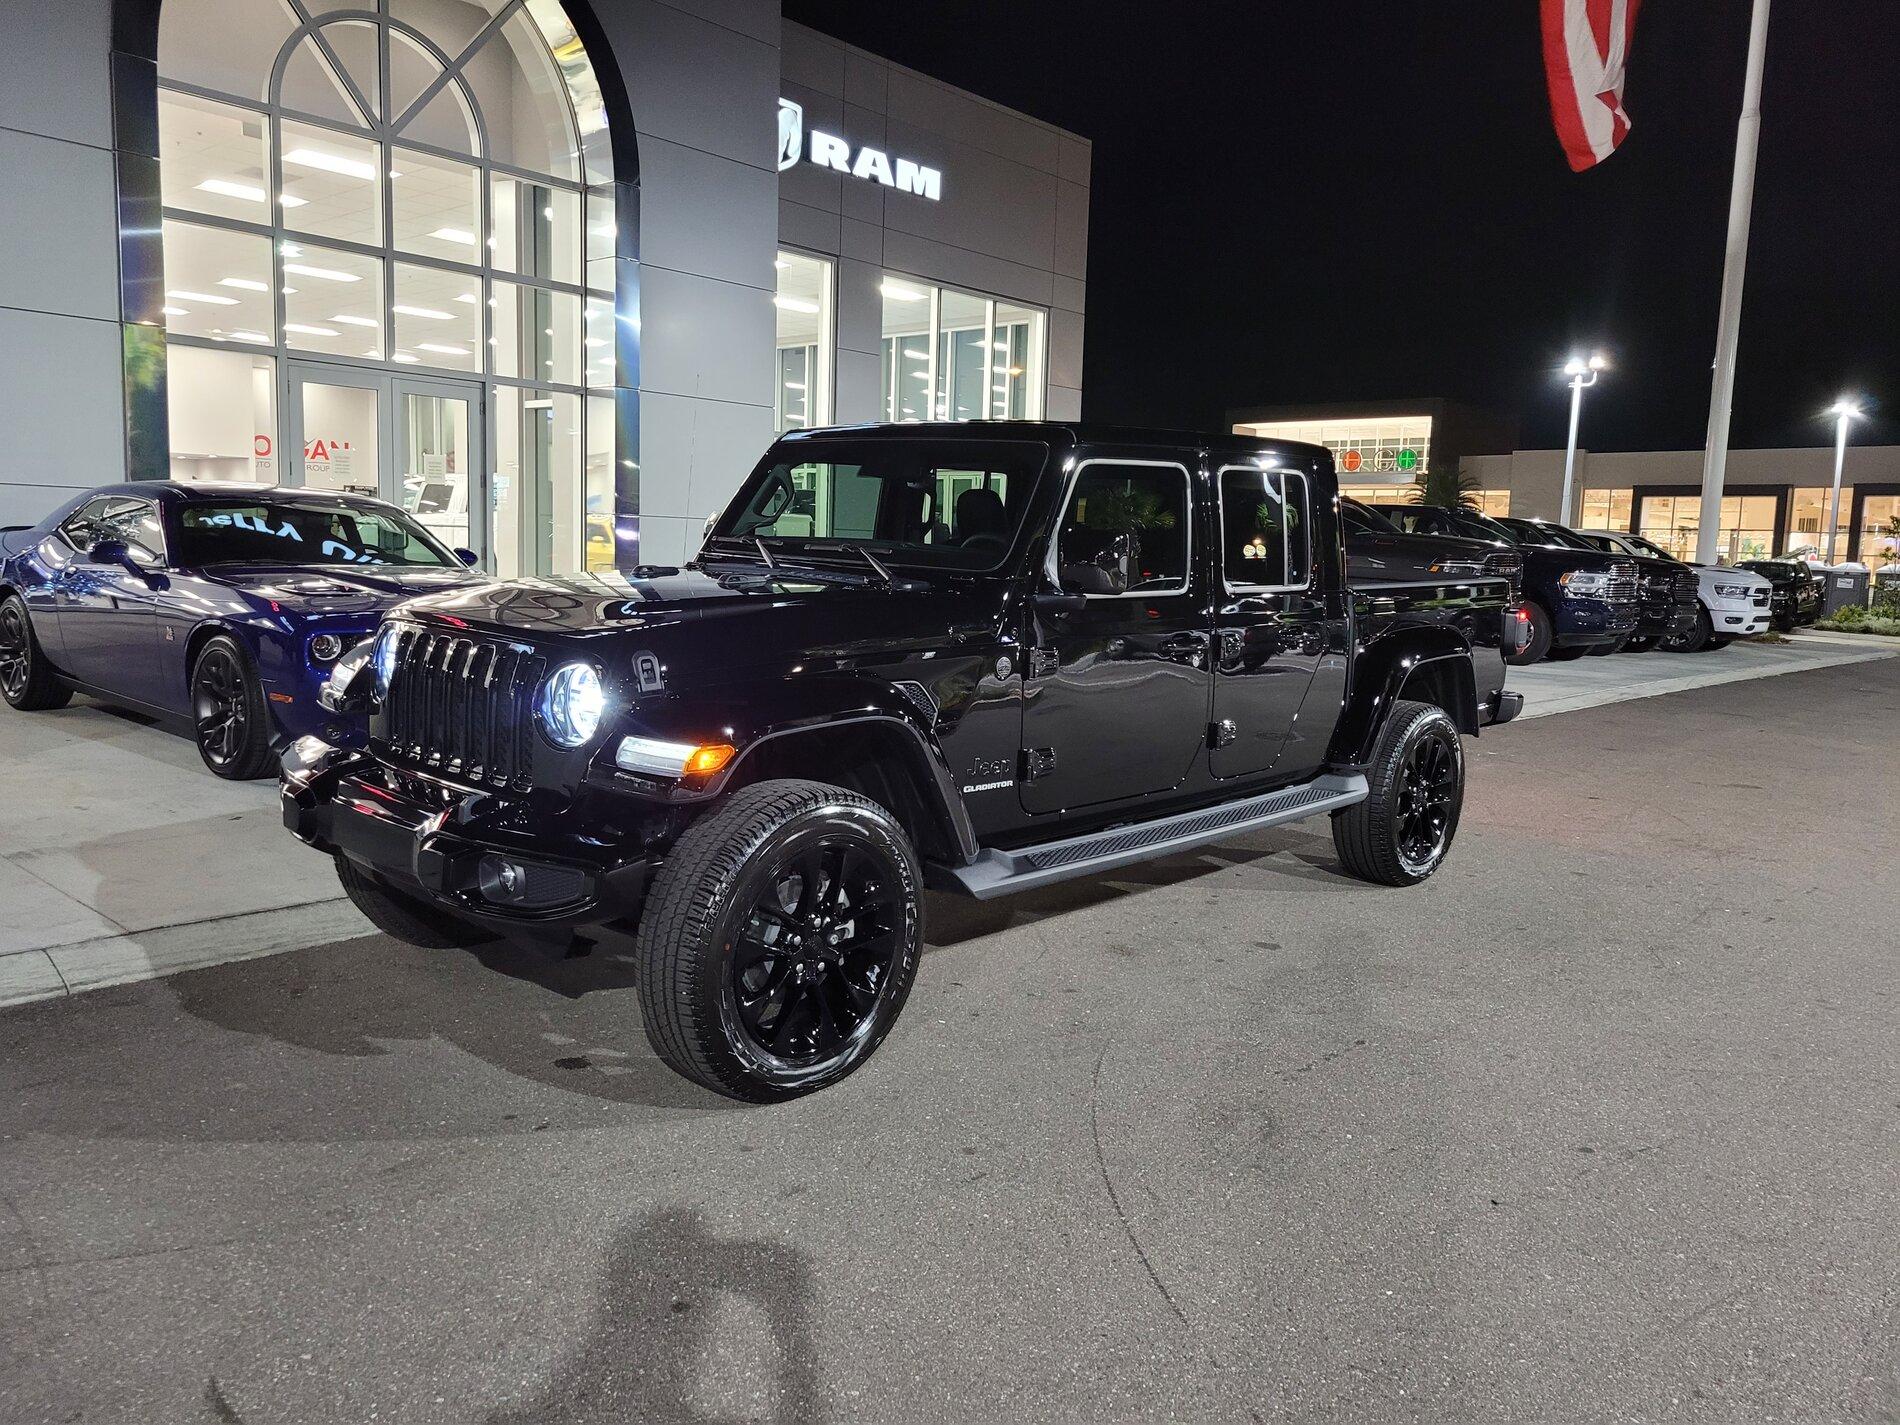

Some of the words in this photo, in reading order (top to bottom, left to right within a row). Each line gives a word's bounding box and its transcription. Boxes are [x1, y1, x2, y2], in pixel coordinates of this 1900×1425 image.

[809, 129, 942, 201] RAM
[306, 463, 331, 473] ROUP
[966, 757, 1011, 779] Jeep
[963, 780, 1014, 793] GLADIATOR
